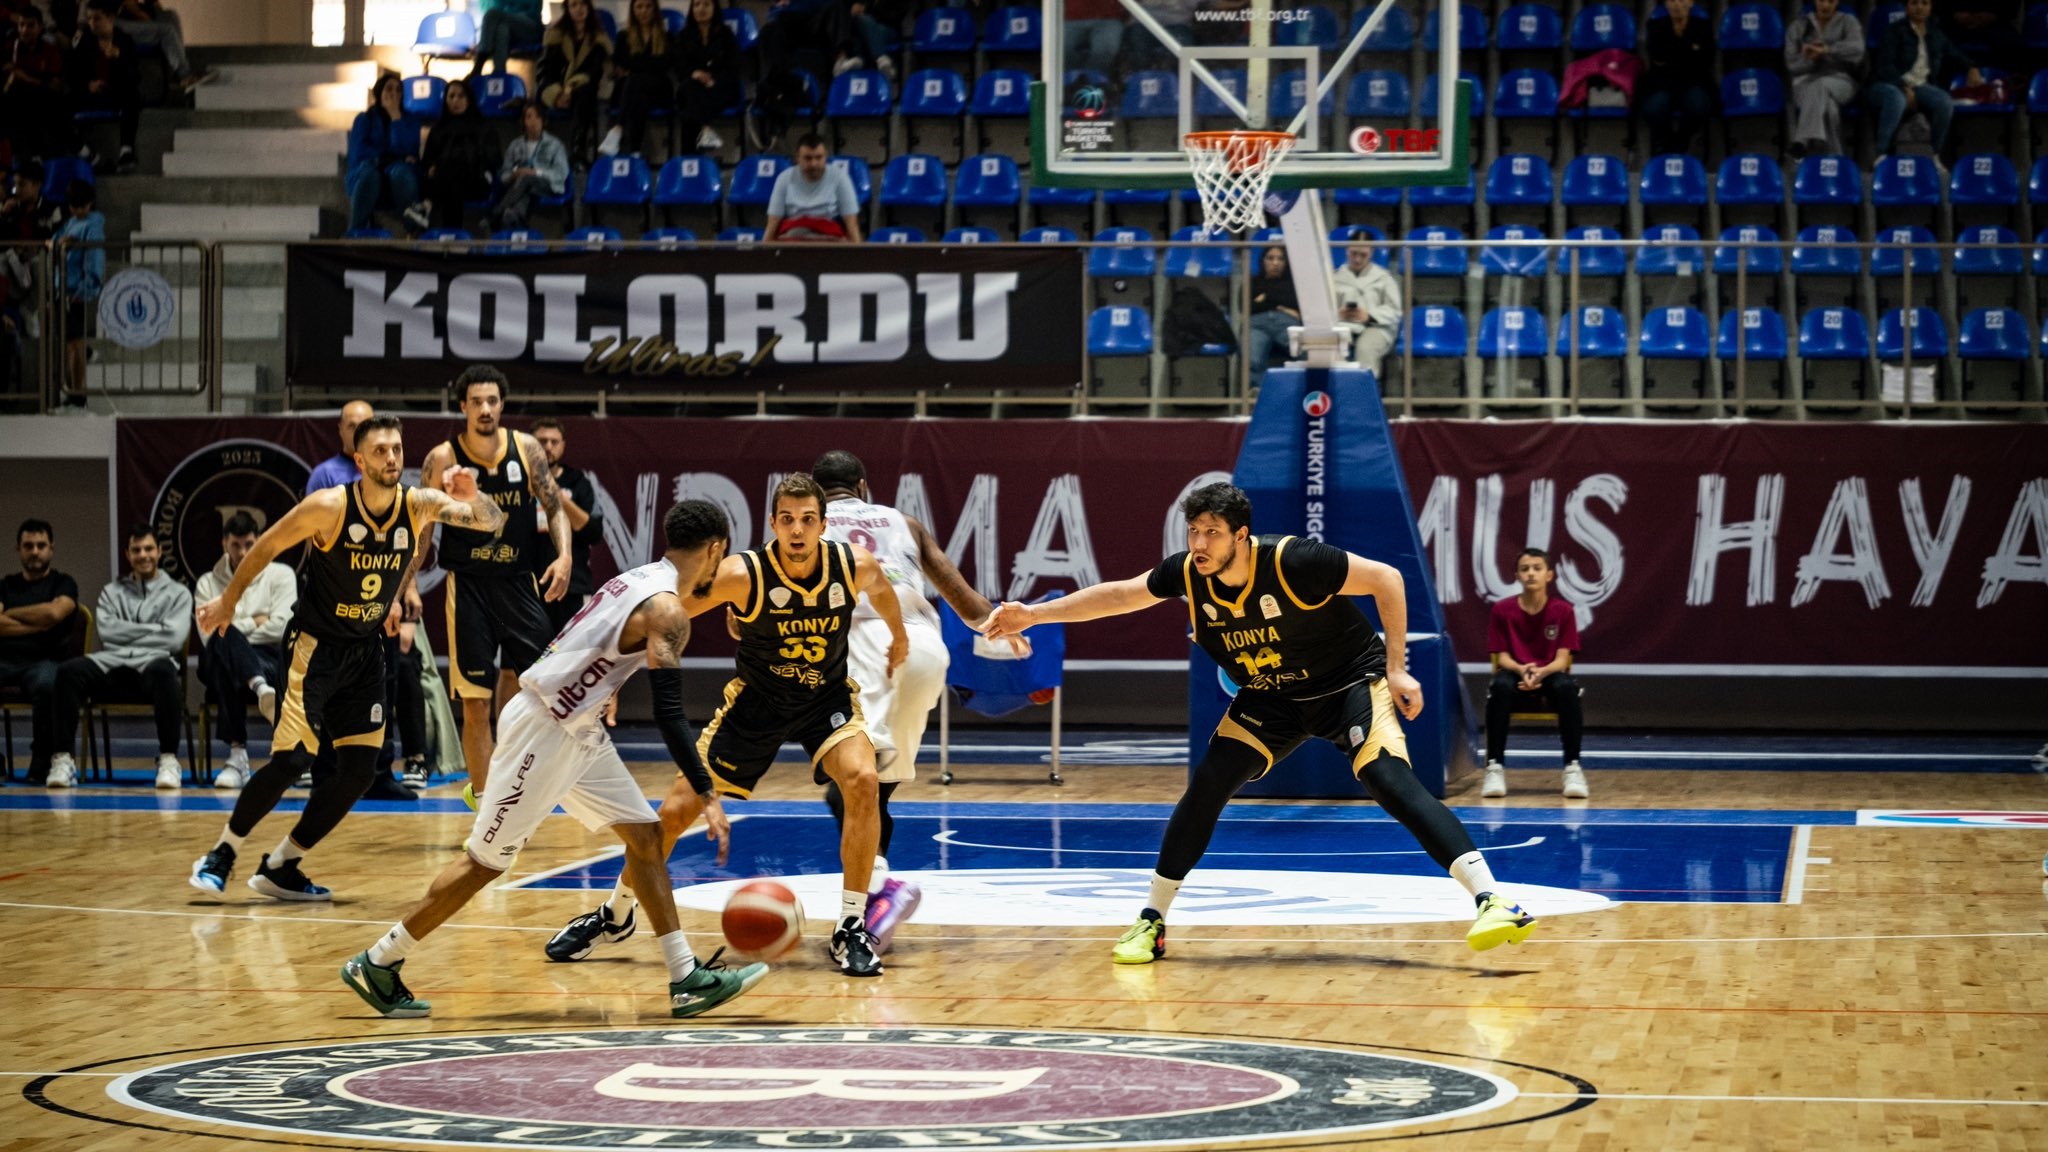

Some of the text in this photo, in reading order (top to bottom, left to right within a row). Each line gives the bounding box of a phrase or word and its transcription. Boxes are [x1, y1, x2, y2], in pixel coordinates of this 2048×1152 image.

[1383, 128, 1440, 152] TBF
[343, 270, 1019, 363] KOLORDU
[582, 334, 783, 378] Ultras!
[1686, 472, 2048, 610] HAYA
[350, 551, 402, 571] KONYA
[360, 572, 383, 602] 9
[776, 615, 841, 637] KONYA
[1221, 625, 1281, 652] KONYA
[778, 635, 828, 664] 33
[1235, 645, 1282, 676] 14
[169, 1035, 624, 1119] BASKETBOL
[335, 1117, 1125, 1147] KULÜBÜ
